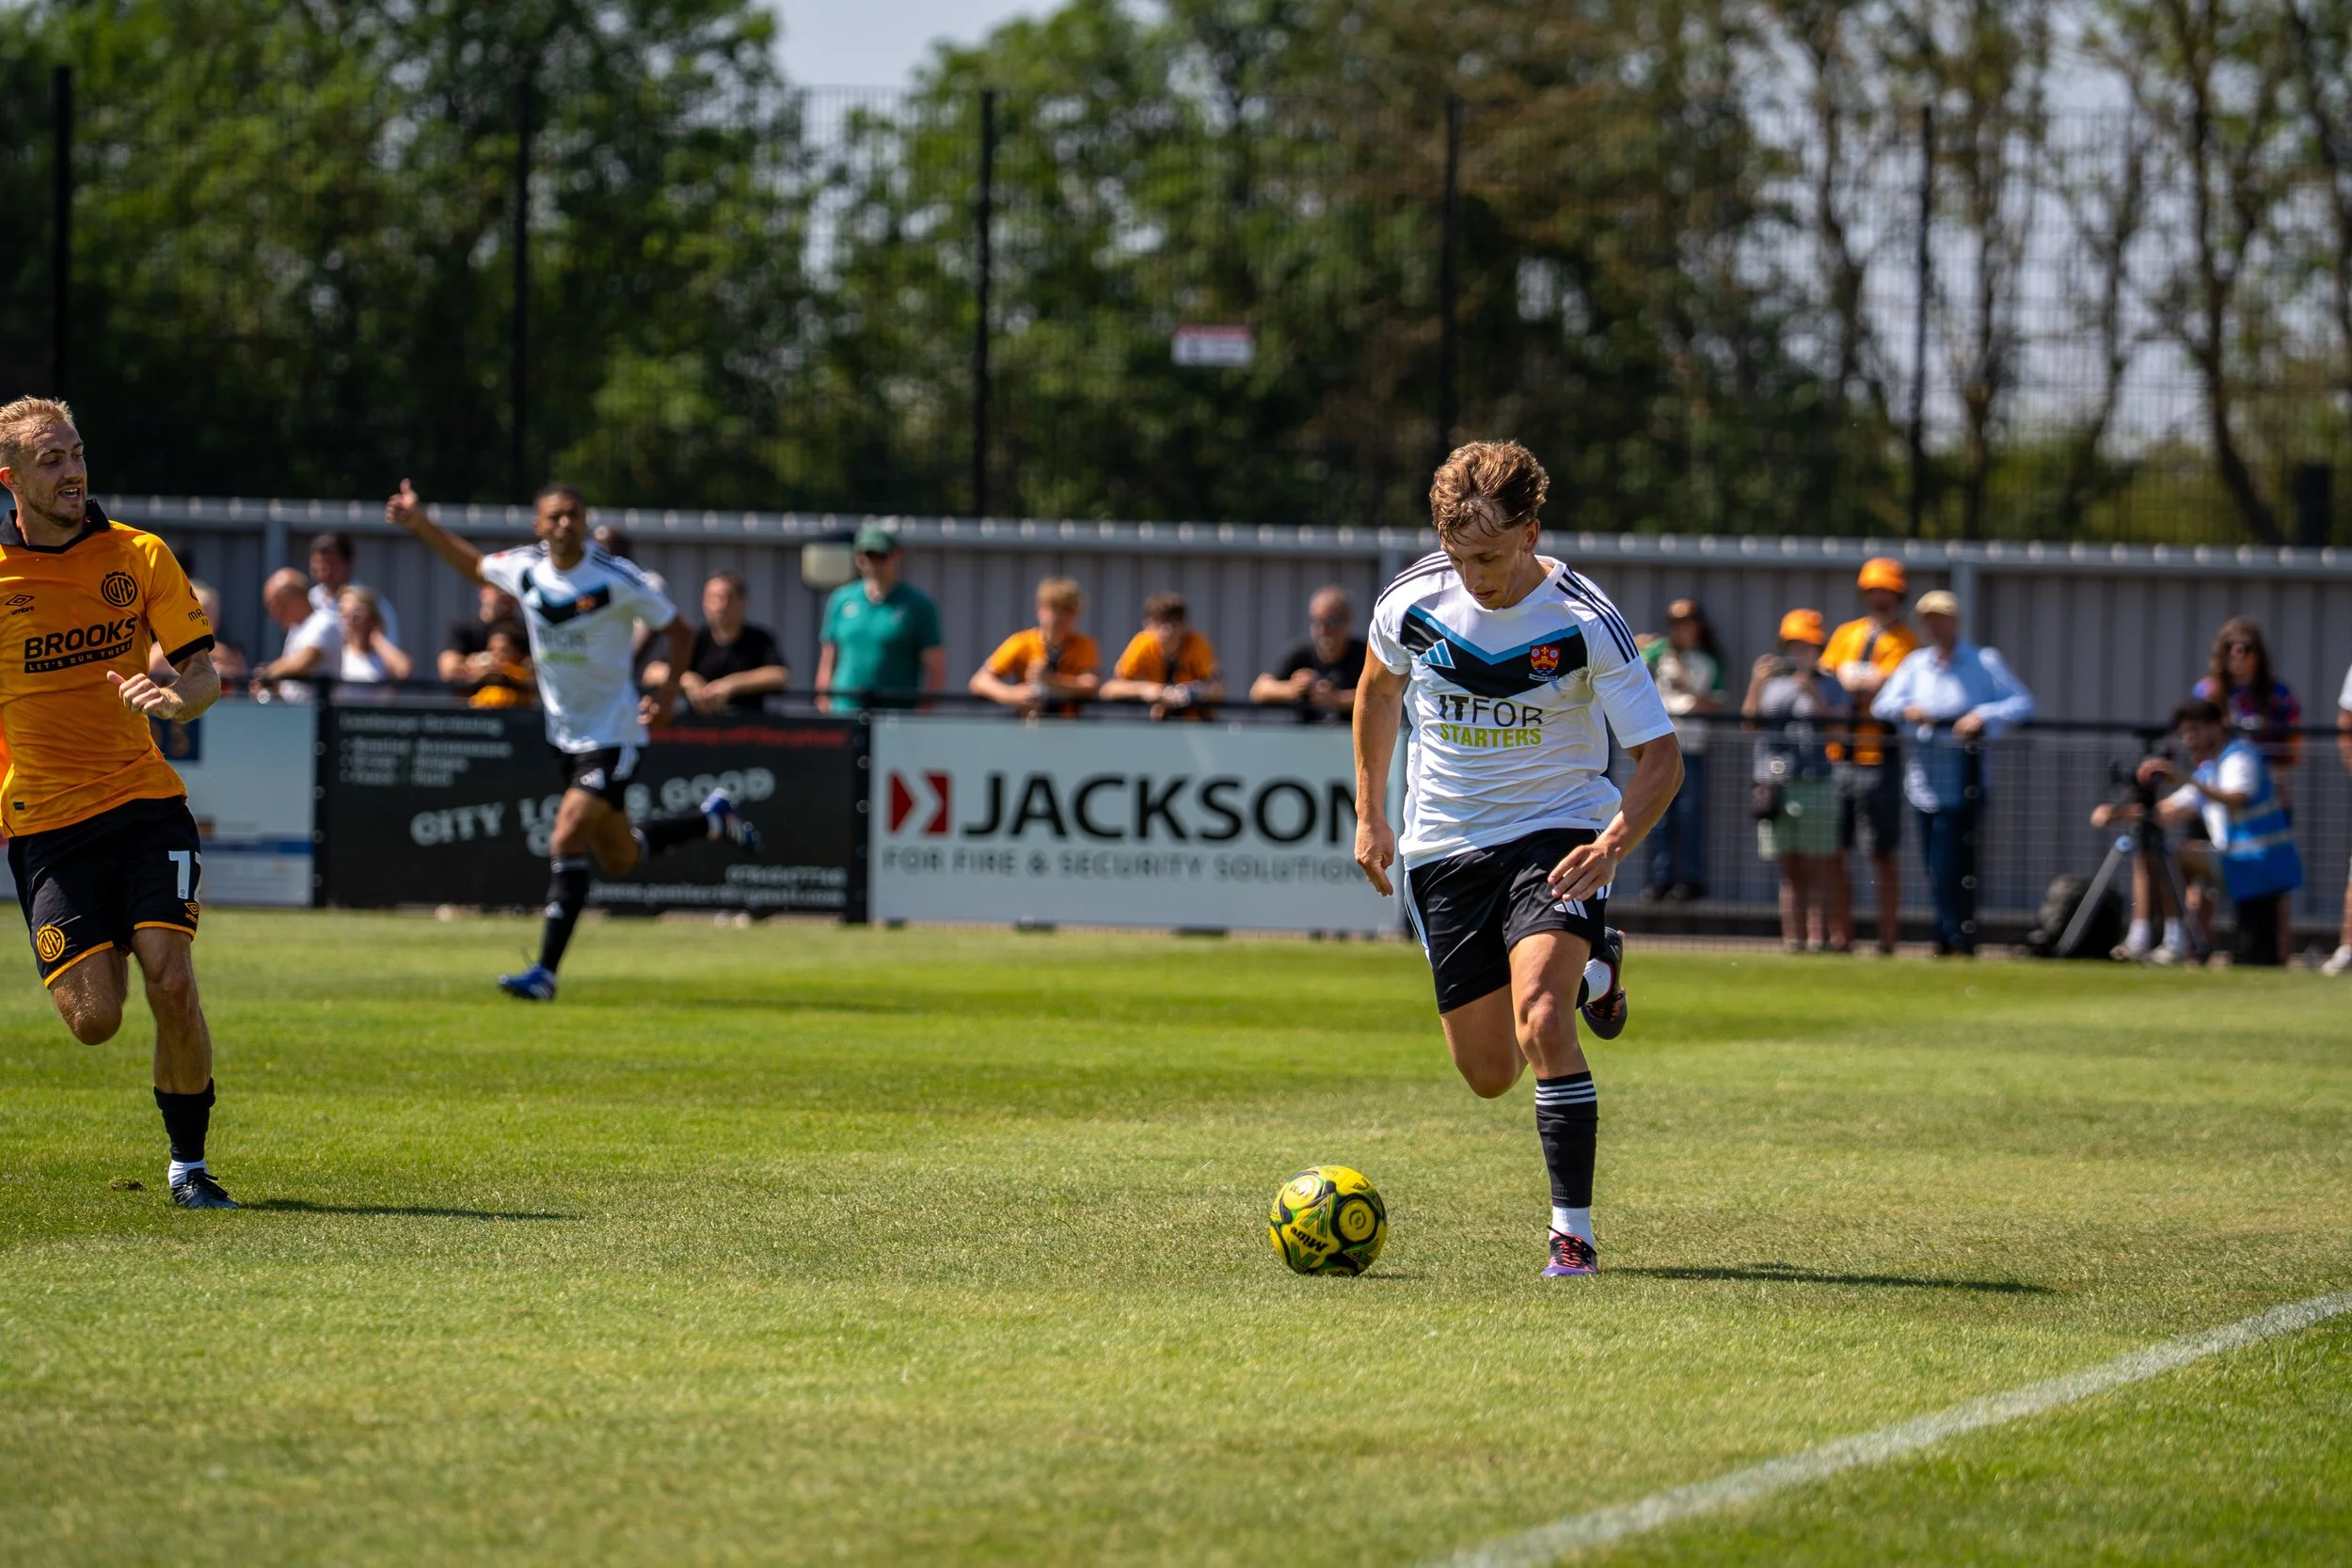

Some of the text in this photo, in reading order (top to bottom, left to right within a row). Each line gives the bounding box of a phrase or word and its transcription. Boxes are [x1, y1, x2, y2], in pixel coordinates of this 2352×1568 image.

[10, 606, 35, 615] umbro
[188, 609, 204, 622] MA
[24, 616, 137, 659] BROOKS
[28, 660, 64, 672] LET'S
[71, 654, 93, 664] RUN
[1439, 723, 1542, 748] STARTERS
[410, 802, 503, 847] CITY
[519, 784, 652, 832] LOS
[661, 767, 775, 810] GOOD
[168, 850, 201, 903] 1
[882, 846, 945, 876] FOR
[951, 847, 1019, 878] FIRE
[1026, 848, 1051, 879] &
[1057, 849, 1206, 880] SECURITY
[1214, 852, 1364, 884] SOLUTION
[1290, 1227, 1329, 1252] Mitre
